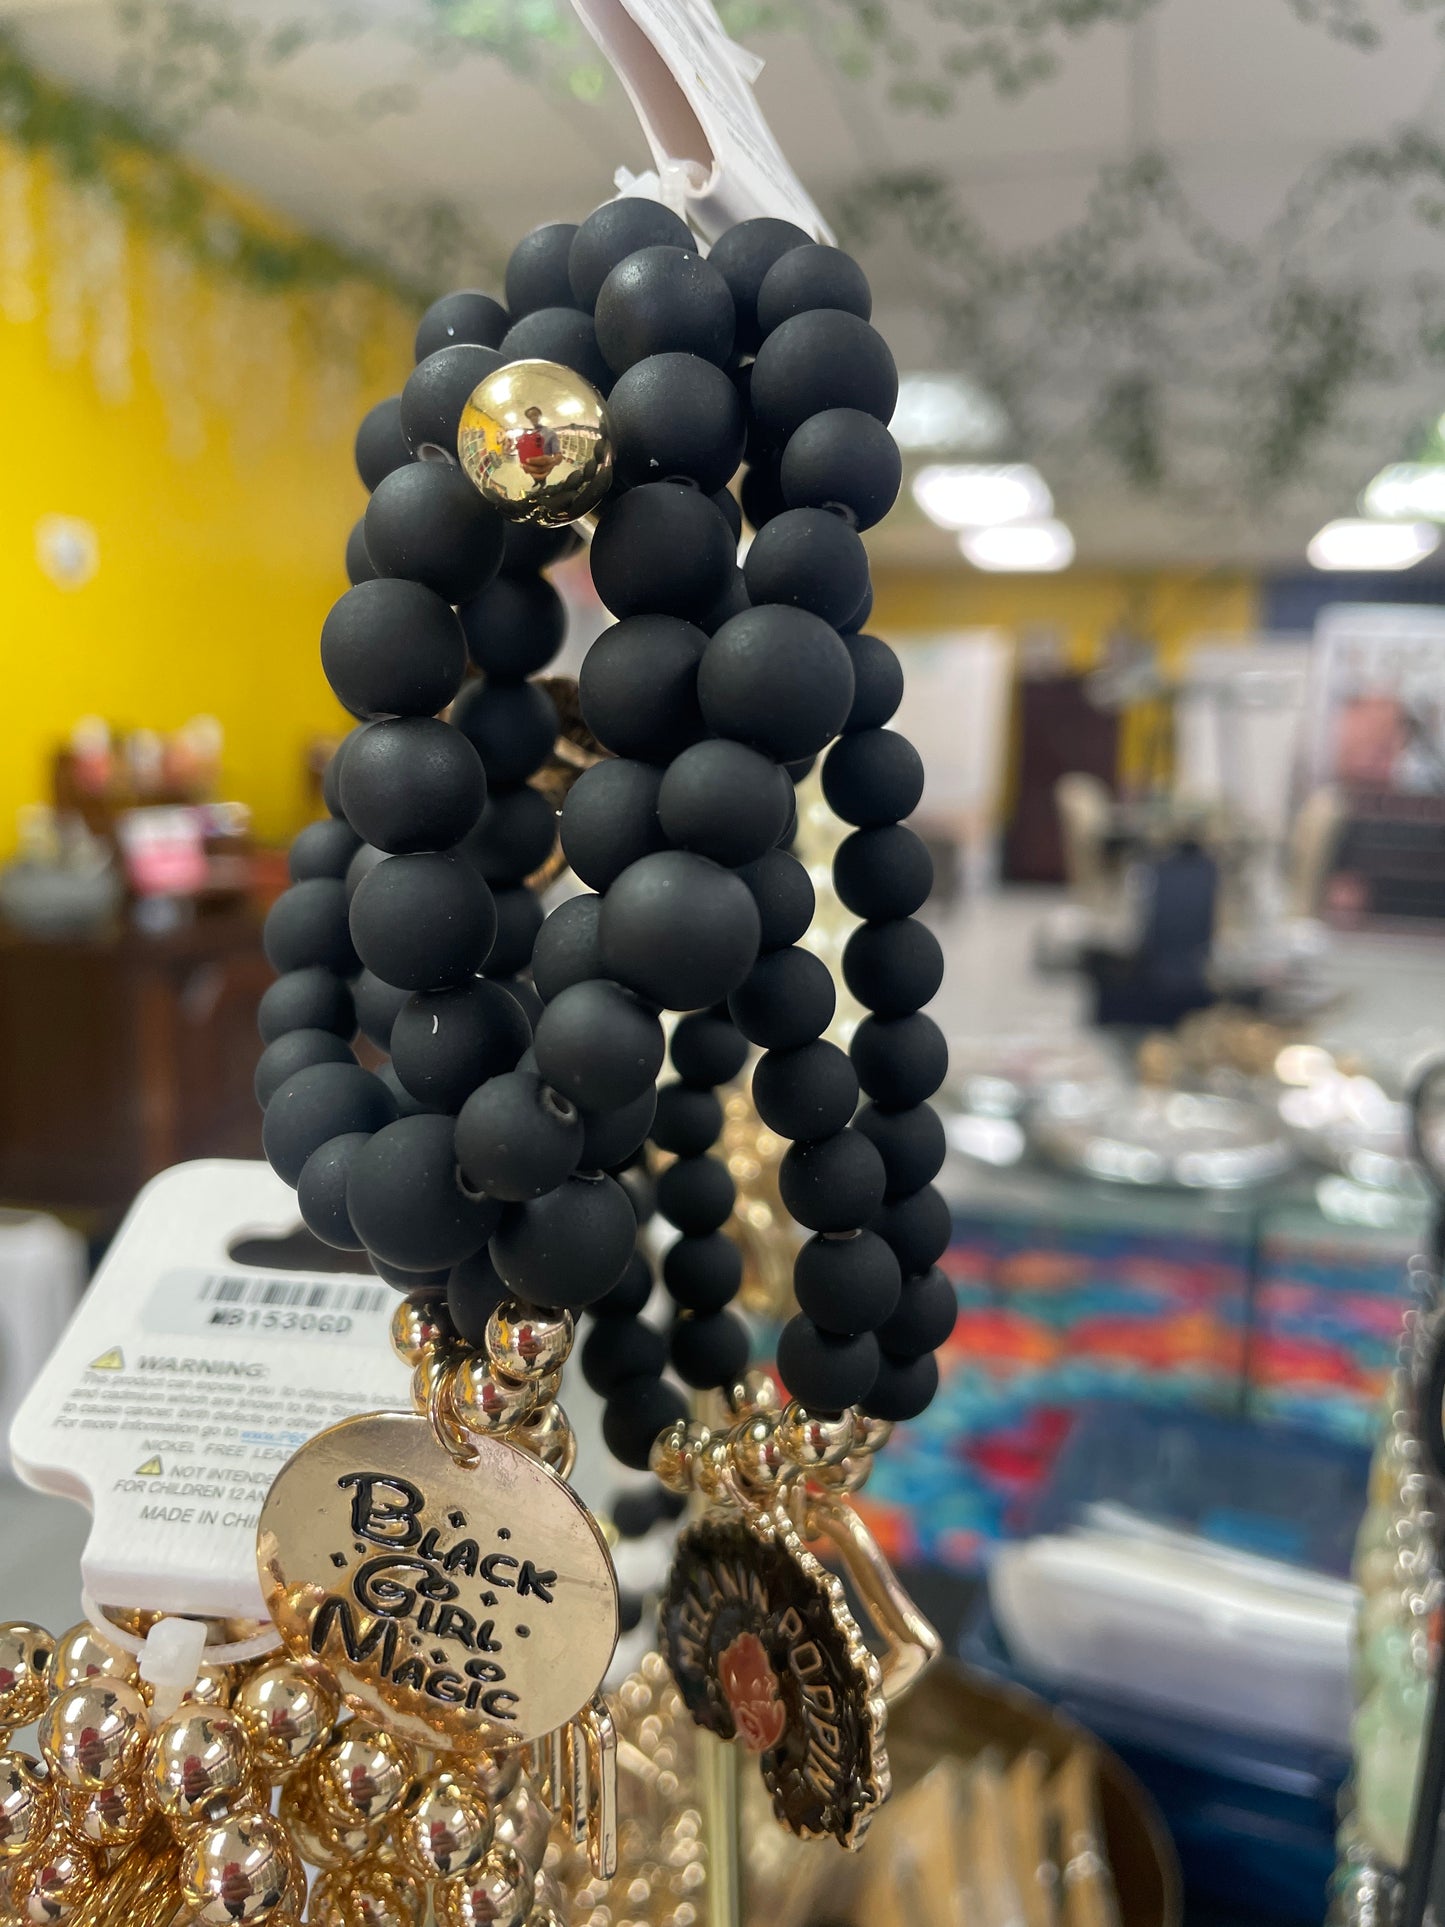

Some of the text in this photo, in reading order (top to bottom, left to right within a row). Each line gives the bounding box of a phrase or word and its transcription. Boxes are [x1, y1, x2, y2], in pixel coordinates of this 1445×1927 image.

[203, 1443, 248, 1457] FREE
[169, 1465, 276, 1486] NOT INTENDE
[113, 1479, 148, 1493] FOR
[150, 1480, 225, 1499] CHILDREN
[245, 1488, 268, 1502] AN
[140, 1505, 196, 1523] MADE
[198, 1509, 219, 1526] IN
[337, 1472, 558, 1604] BLACK
[353, 1554, 502, 1652] GIRL
[311, 1597, 520, 1721] MAGIC
